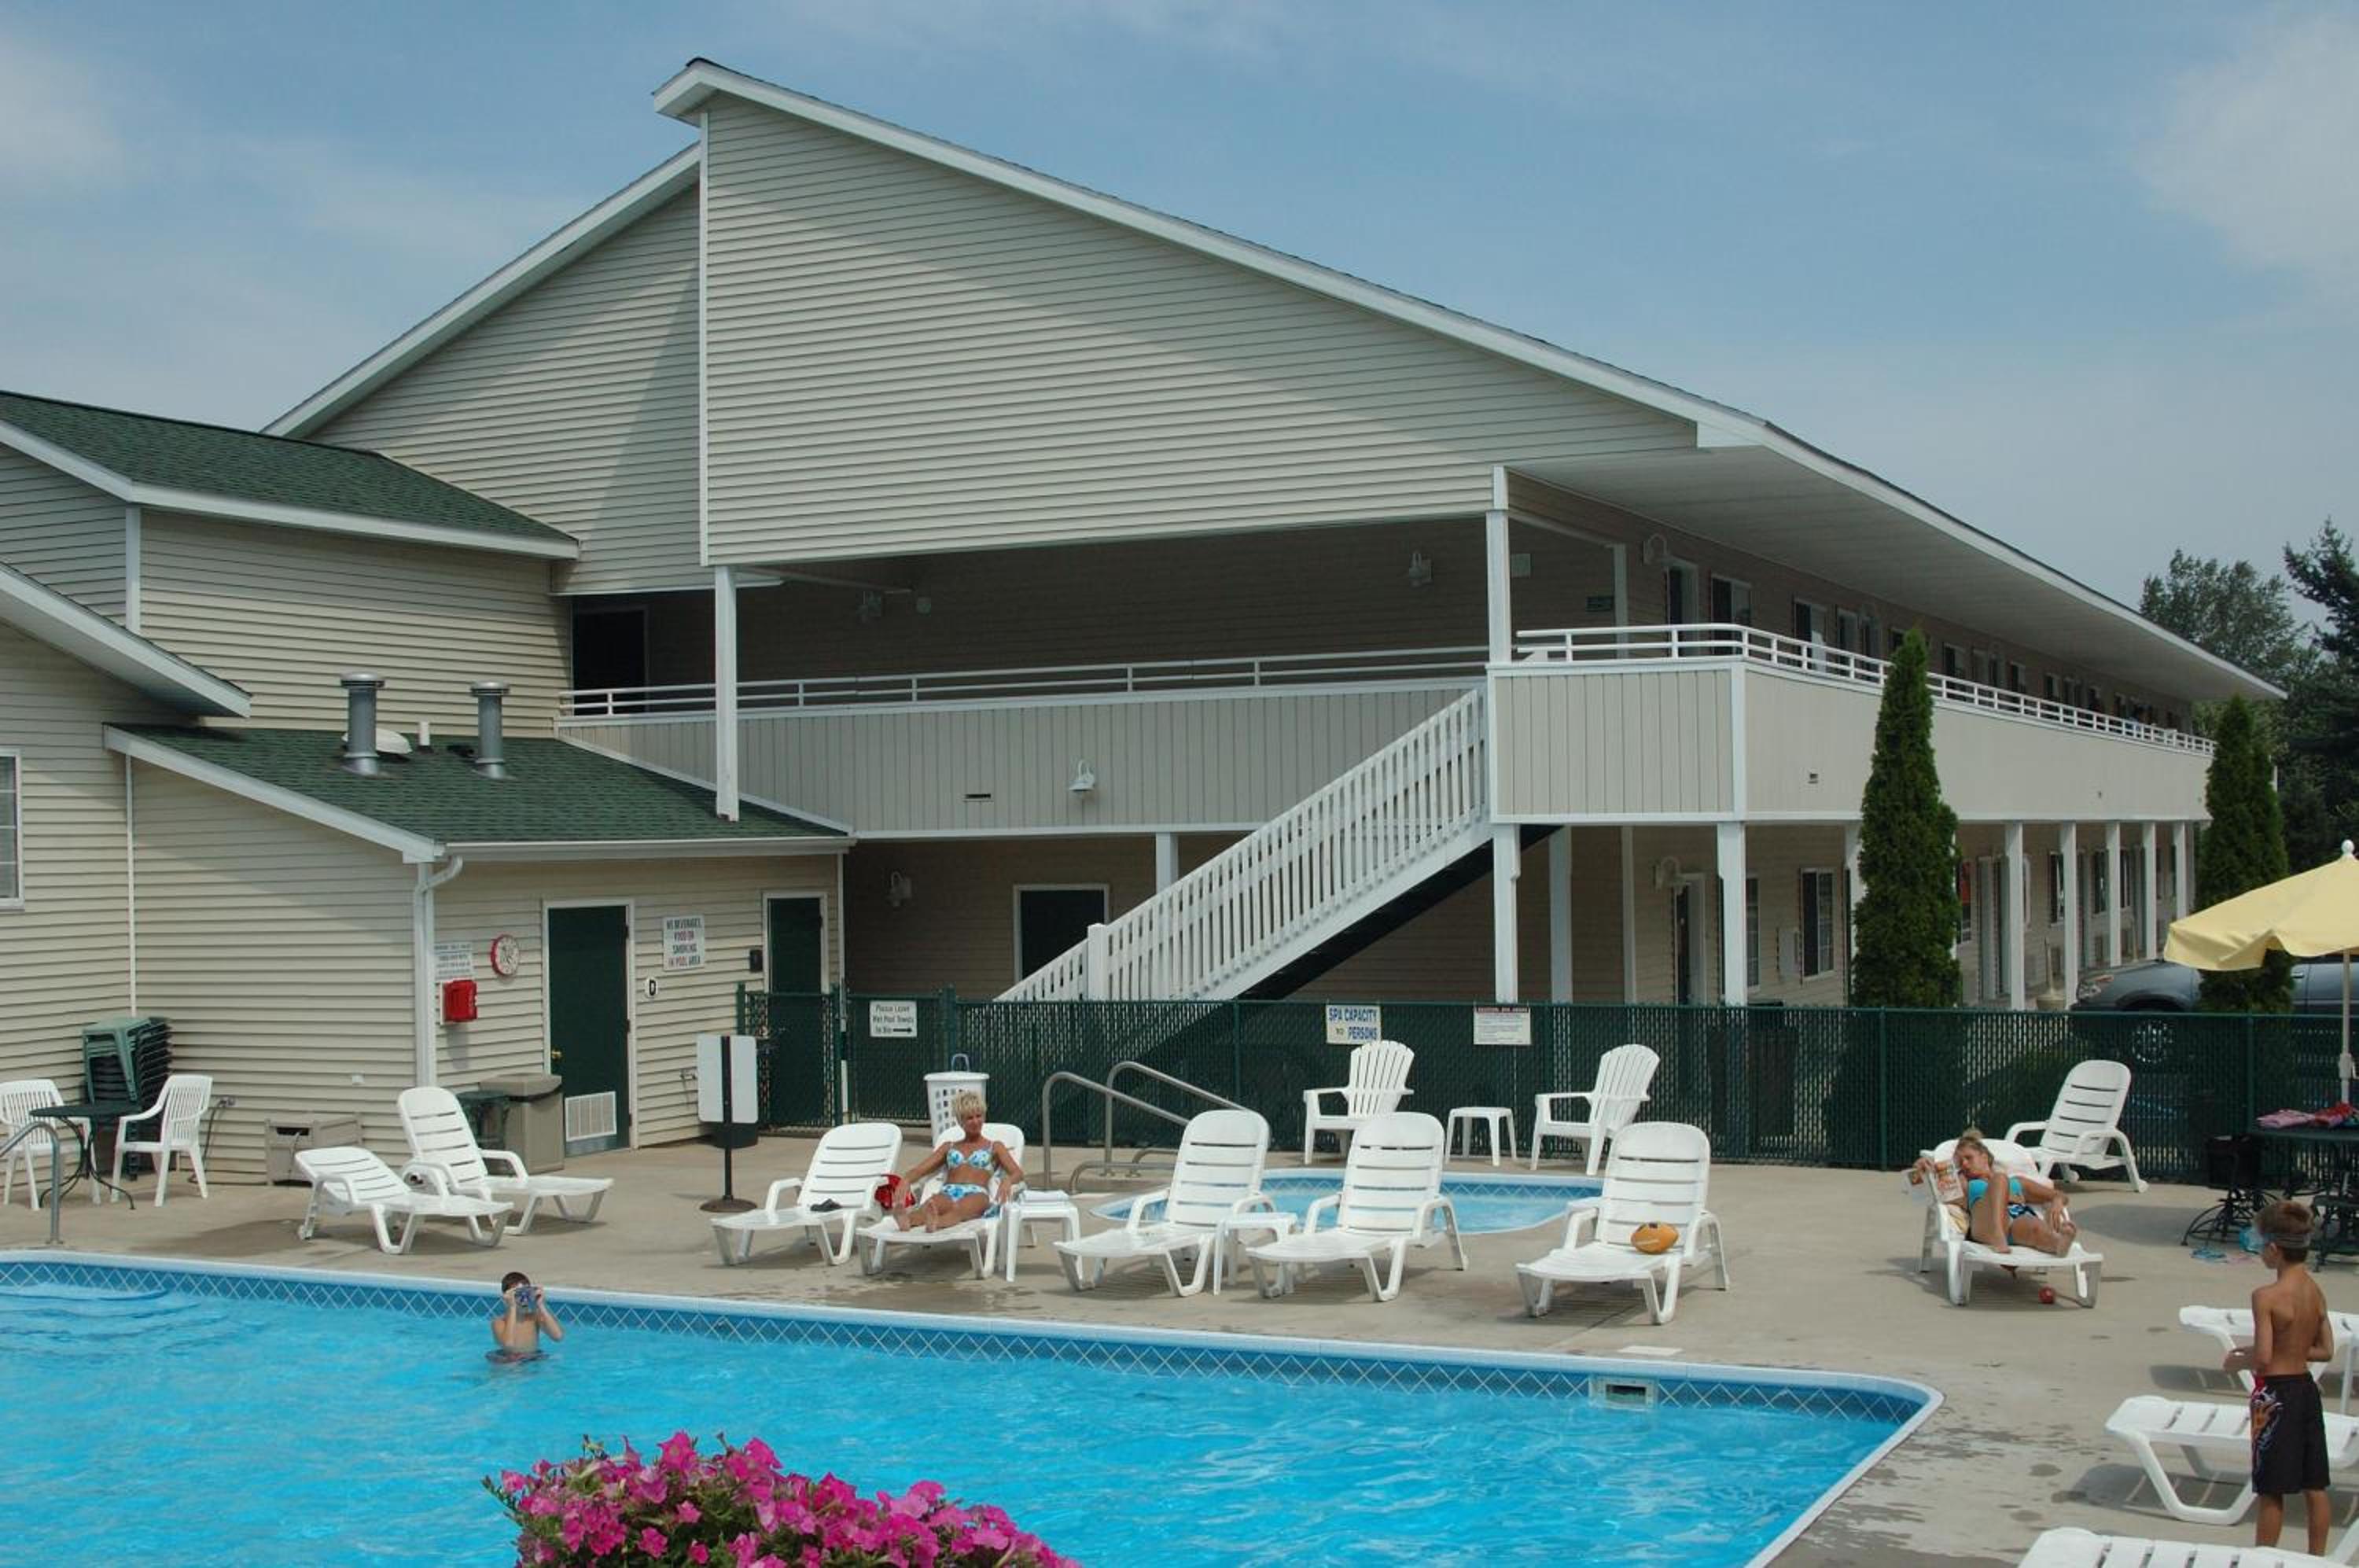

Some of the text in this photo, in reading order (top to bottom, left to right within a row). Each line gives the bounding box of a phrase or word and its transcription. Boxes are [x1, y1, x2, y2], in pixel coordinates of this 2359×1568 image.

[650, 980, 656, 996] D
[1329, 1007, 1378, 1021] SPA CAPACITY
[1348, 1026, 1377, 1040] PERSONS
